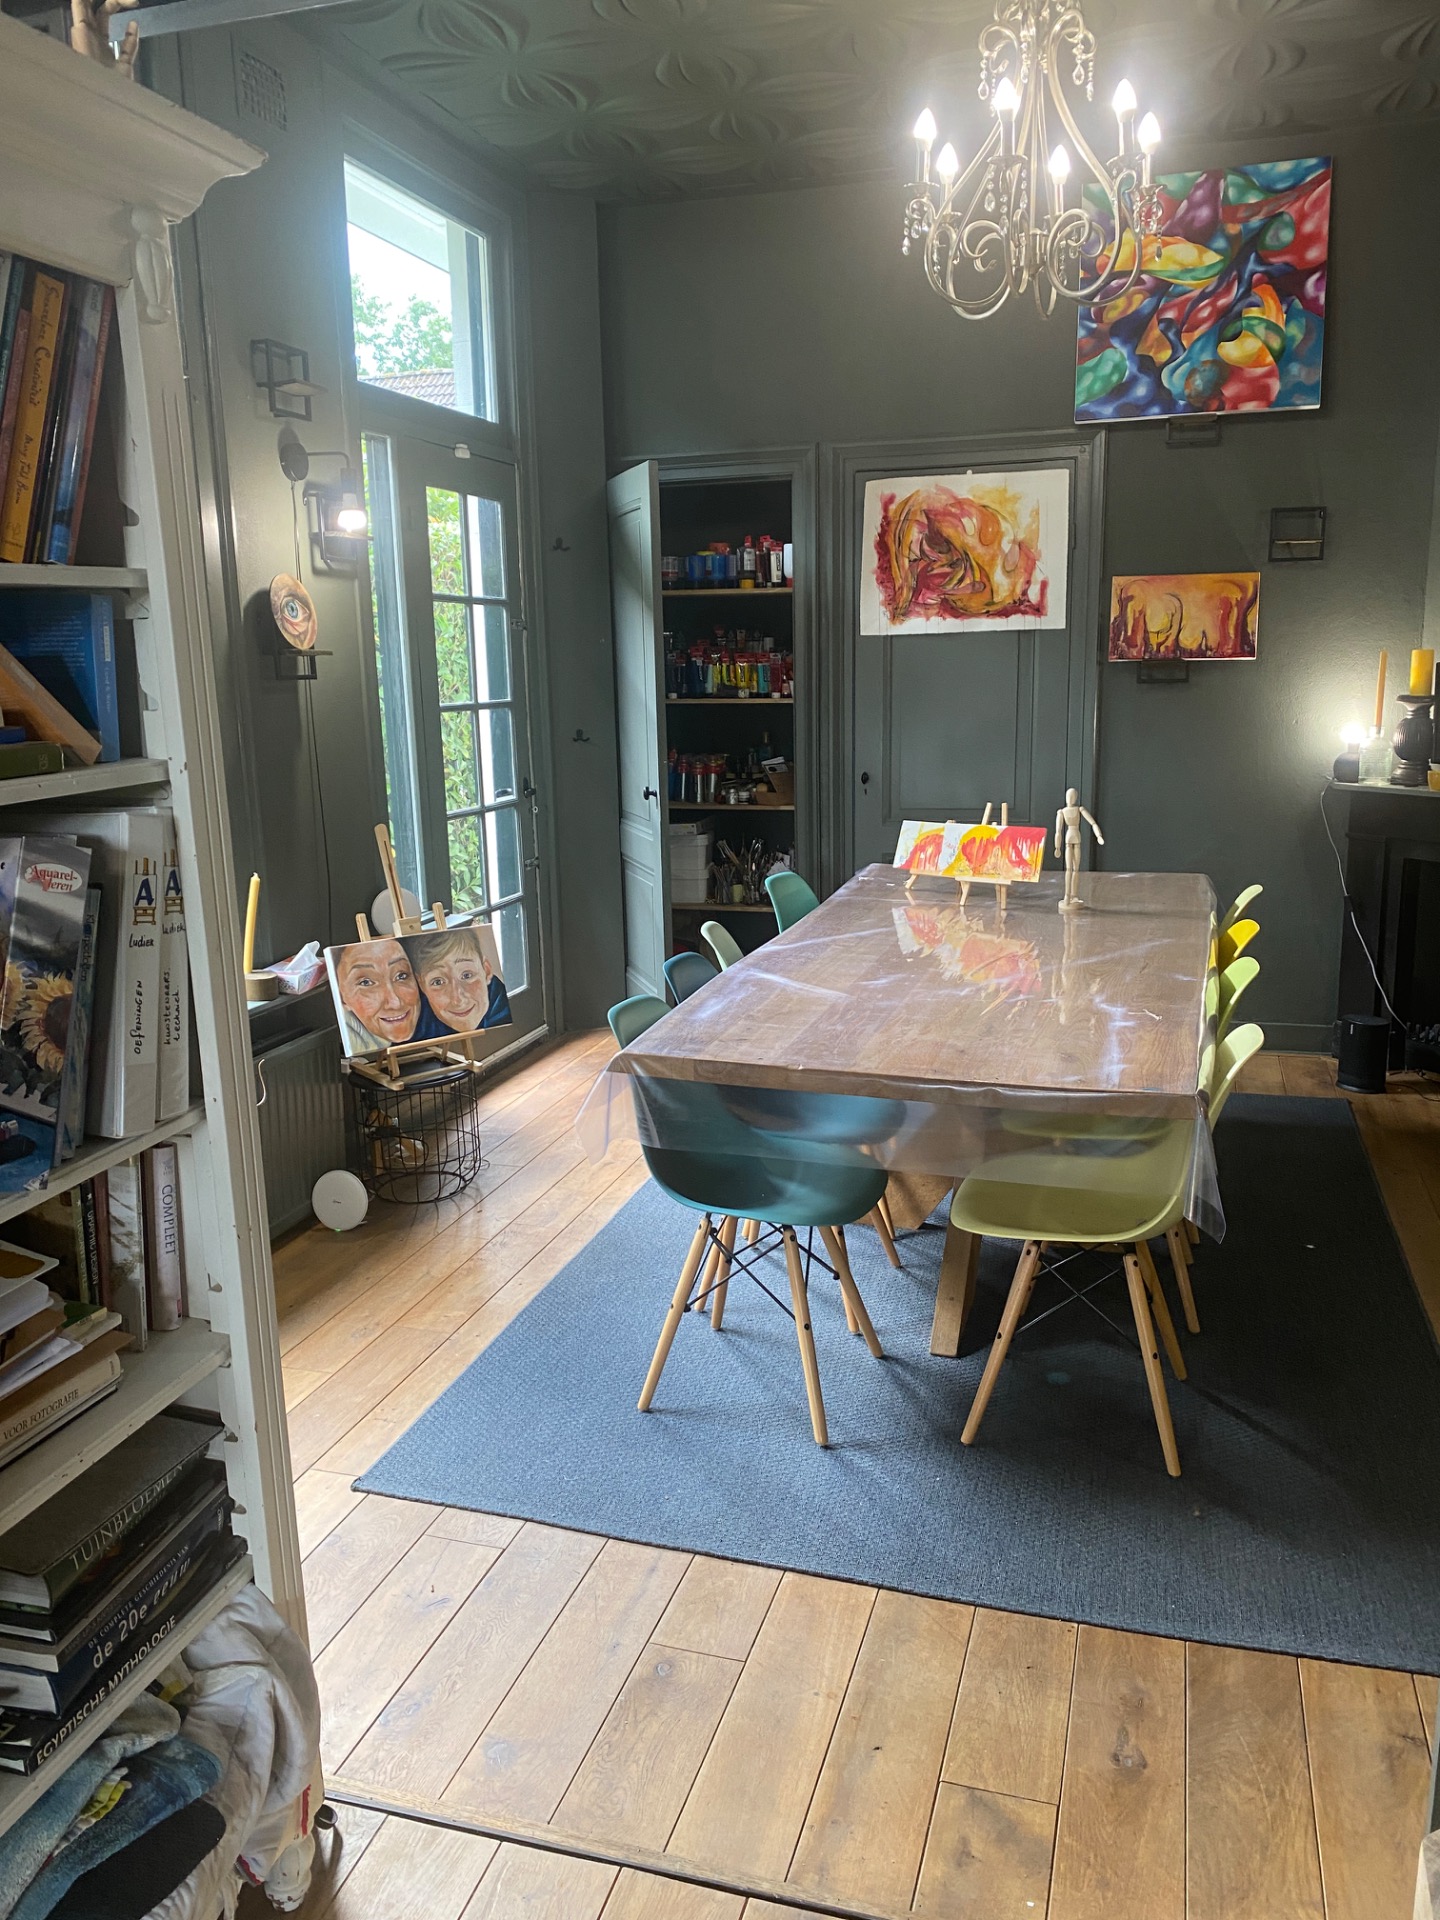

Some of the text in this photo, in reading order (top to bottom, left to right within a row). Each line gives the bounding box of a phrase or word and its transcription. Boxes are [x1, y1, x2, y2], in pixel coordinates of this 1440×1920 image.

[162, 1184, 176, 1255] COMPLEET
[3, 1389, 79, 1440] VOOR FOTOGRAFIE
[93, 1641, 113, 1669] de
[119, 1605, 148, 1643] 20e
[100, 1601, 134, 1637] COMPLETE
[36, 1688, 106, 1766] EGYPTISCHE
[108, 1615, 177, 1690] MYTHOLOGIE
